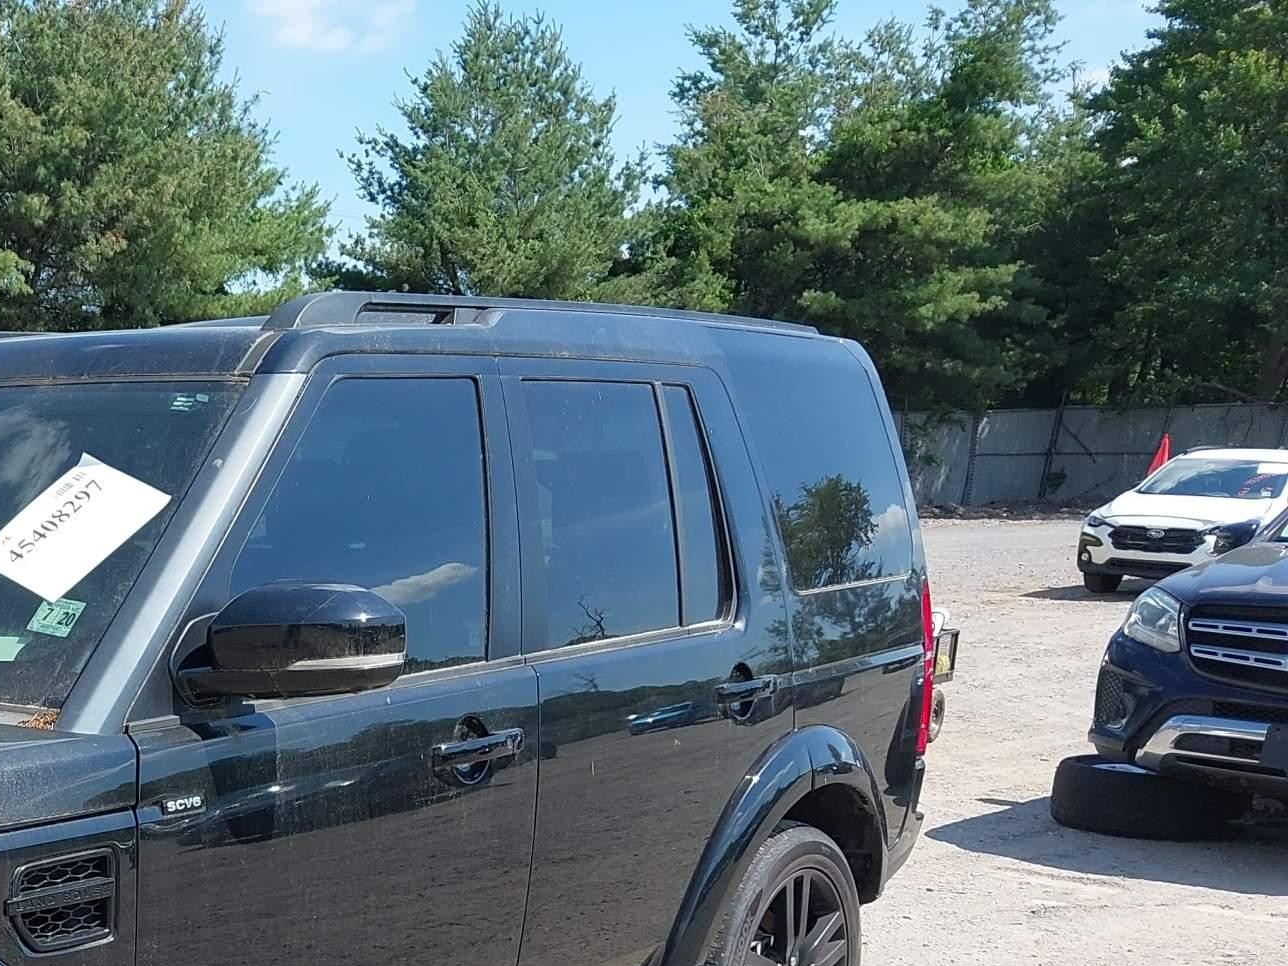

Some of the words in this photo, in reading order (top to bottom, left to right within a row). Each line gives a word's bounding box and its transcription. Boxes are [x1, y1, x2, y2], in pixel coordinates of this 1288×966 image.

[9, 479, 103, 563] 45408297
[43, 607, 55, 621] 7
[56, 611, 76, 627] 20
